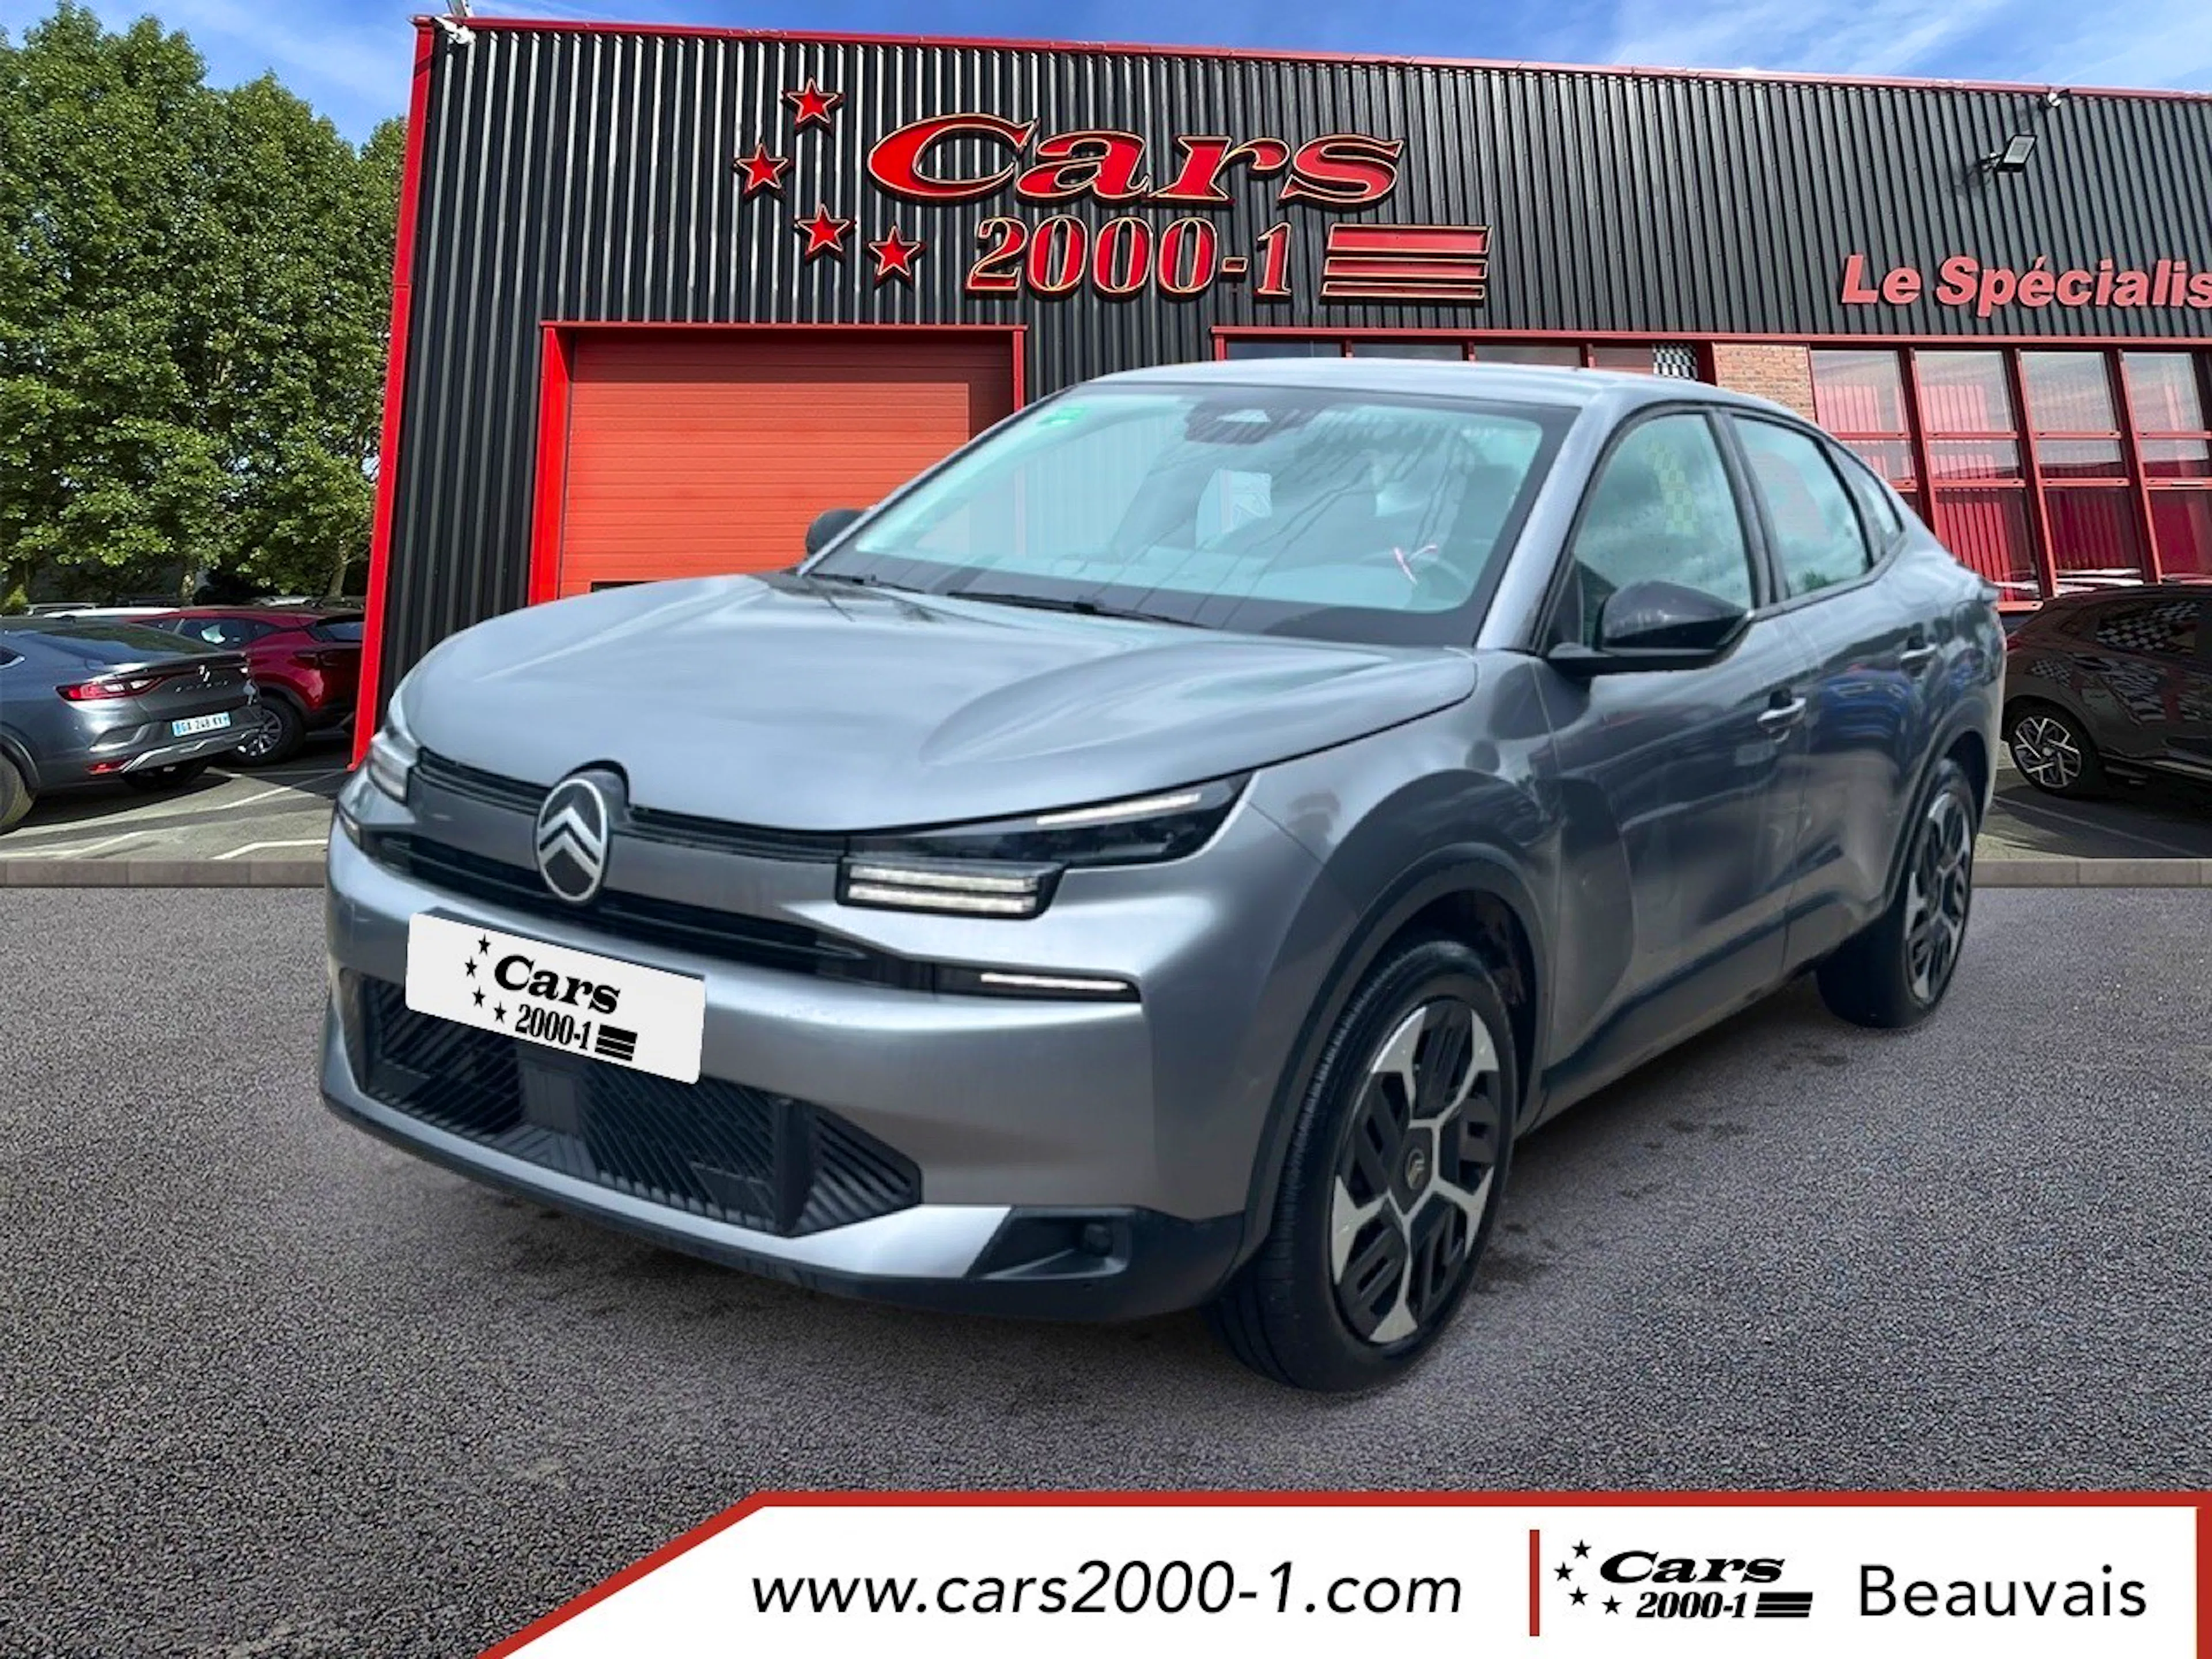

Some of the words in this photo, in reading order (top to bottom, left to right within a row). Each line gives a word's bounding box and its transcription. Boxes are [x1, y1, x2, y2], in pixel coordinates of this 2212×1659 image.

[868, 112, 1405, 204] Cars
[964, 215, 1292, 296] 2000-1
[1842, 255, 1921, 304] Le
